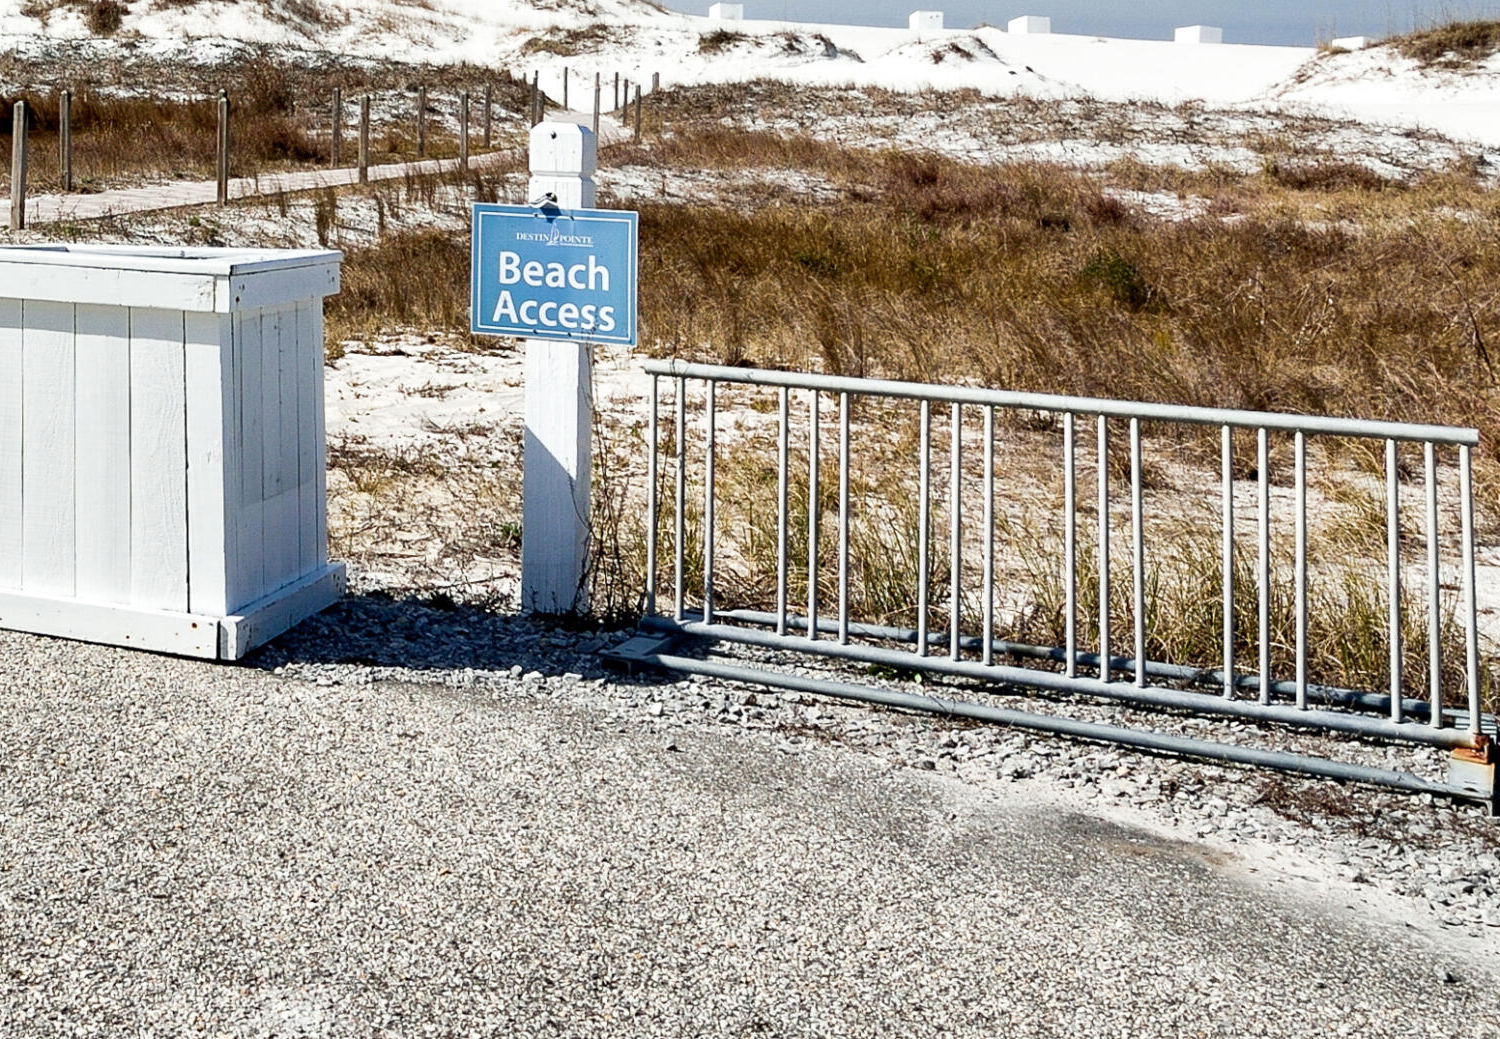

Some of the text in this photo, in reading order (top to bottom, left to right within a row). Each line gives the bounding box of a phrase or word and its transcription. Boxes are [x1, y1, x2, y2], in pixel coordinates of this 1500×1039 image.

[516, 232, 594, 244] DESTIN POINTE
[499, 251, 610, 291] Beach
[492, 290, 616, 332] Access
